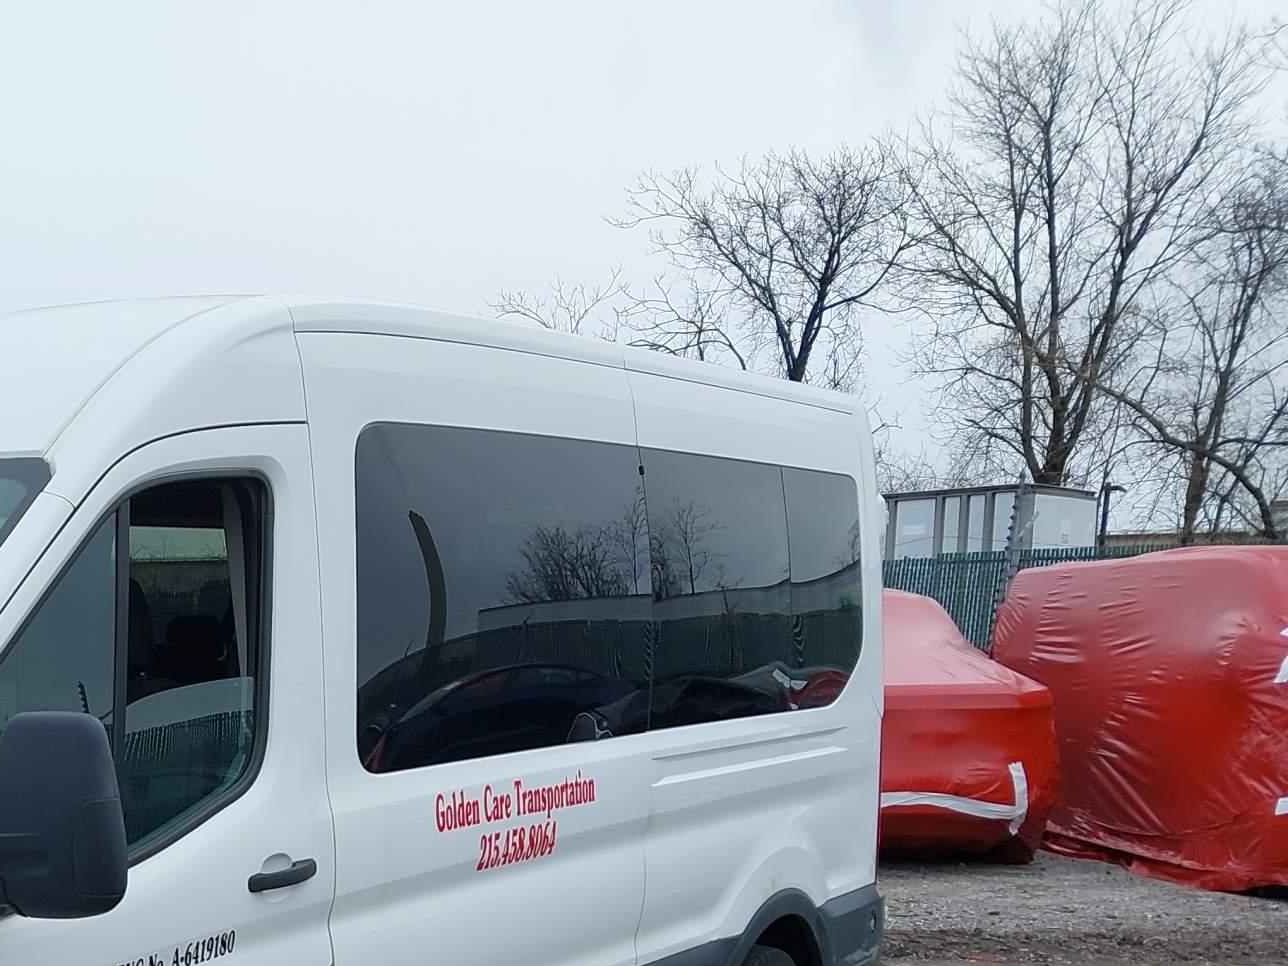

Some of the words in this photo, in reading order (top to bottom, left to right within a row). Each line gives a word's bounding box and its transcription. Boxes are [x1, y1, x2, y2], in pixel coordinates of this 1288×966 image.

[436, 789, 480, 832] Golden
[484, 784, 512, 822] Care
[514, 769, 595, 818] Transportation
[477, 821, 557, 871] 215.458.8064
